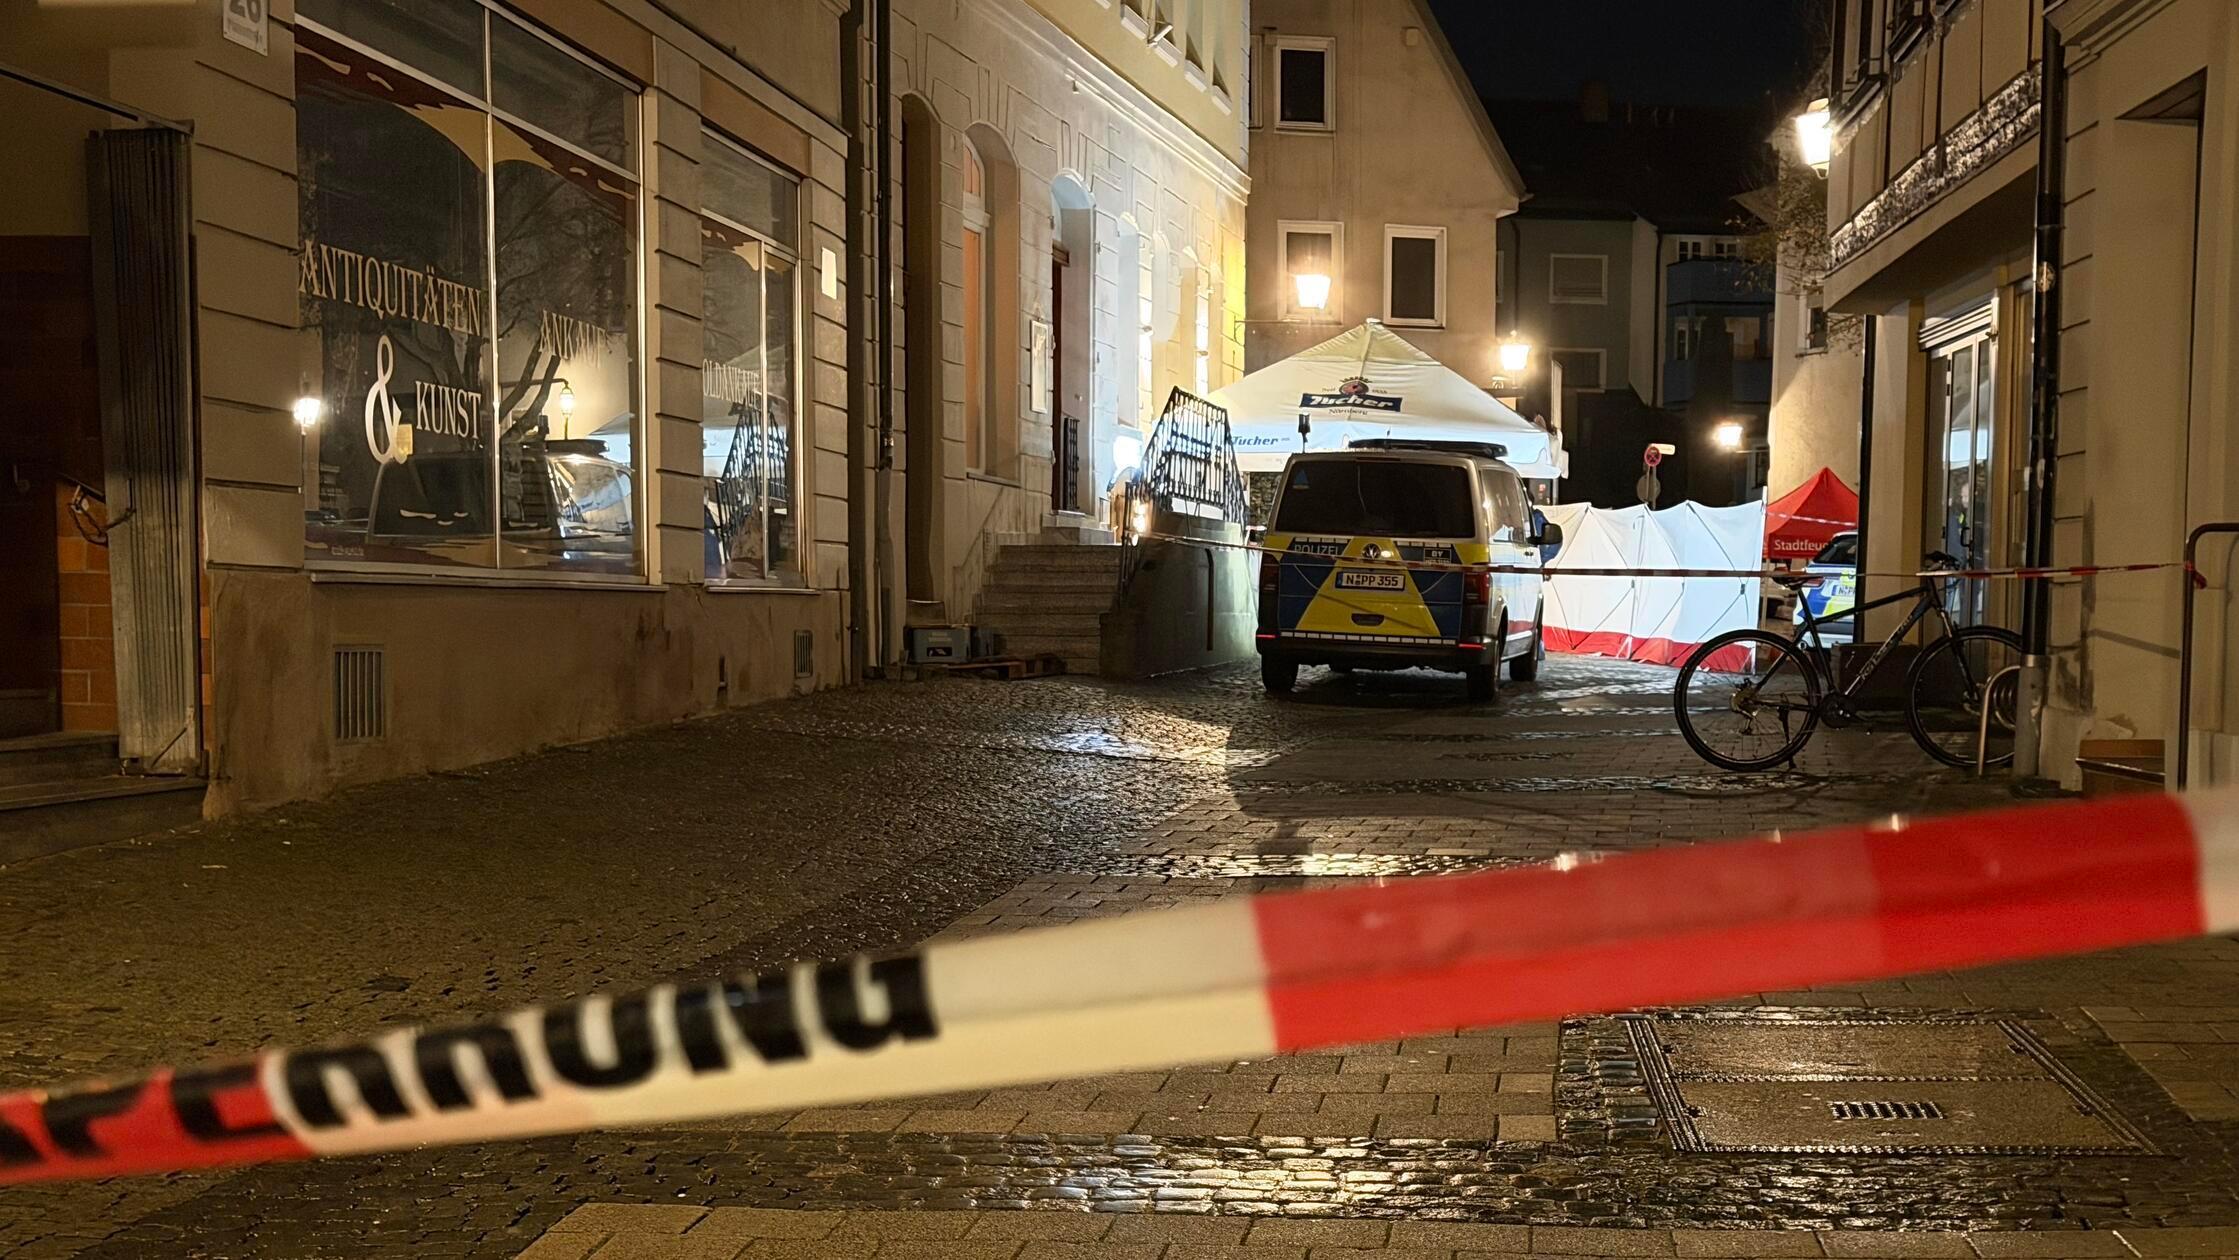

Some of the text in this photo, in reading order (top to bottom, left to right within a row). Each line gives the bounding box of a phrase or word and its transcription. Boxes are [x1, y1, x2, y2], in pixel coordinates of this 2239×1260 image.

[298, 238, 482, 337] ANTIQUITÄTEN
[538, 308, 607, 369] ANKAUF
[365, 334, 482, 464] & KUNST
[702, 358, 761, 411] OLDANKAUF
[1310, 394, 1393, 408] Tucher
[1231, 435, 1279, 446] Tucher
[1294, 544, 1338, 556] POLIZEI
[1377, 576, 1399, 587] 355
